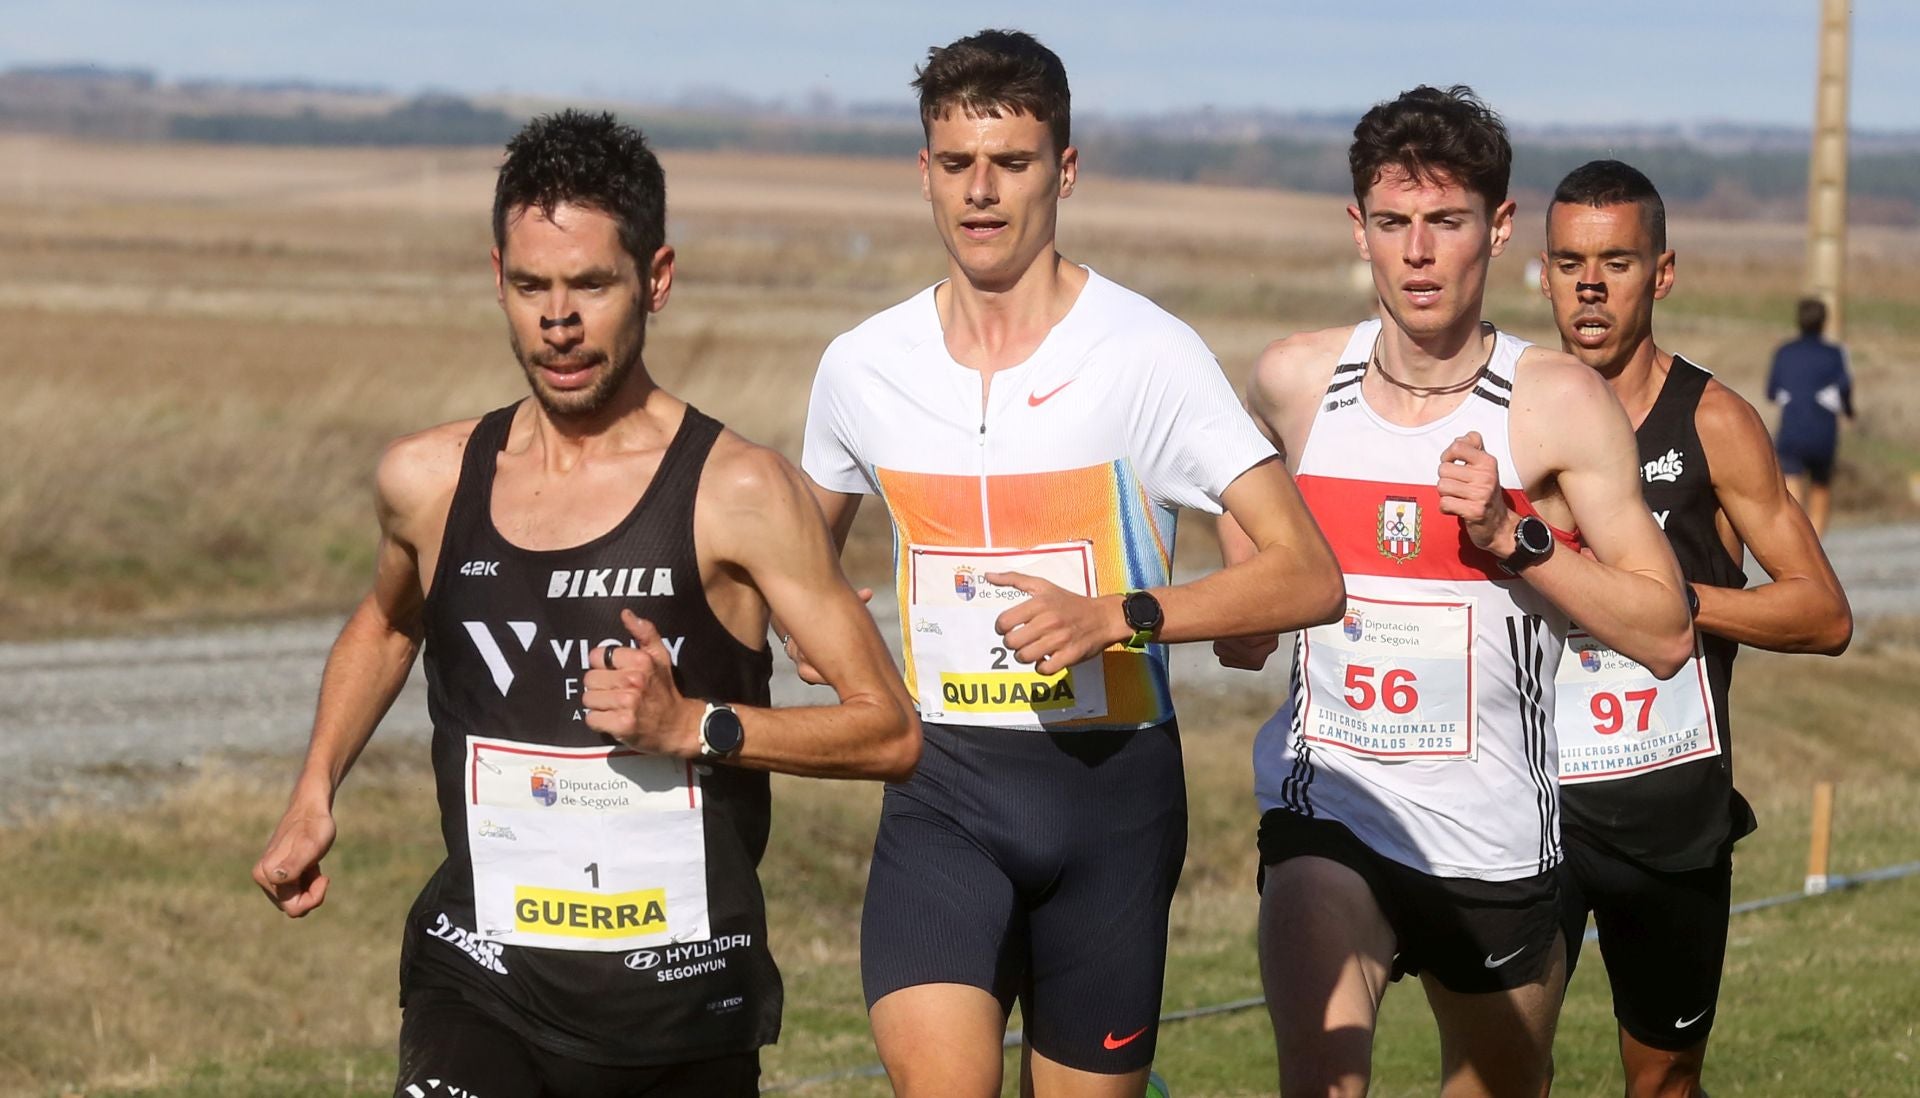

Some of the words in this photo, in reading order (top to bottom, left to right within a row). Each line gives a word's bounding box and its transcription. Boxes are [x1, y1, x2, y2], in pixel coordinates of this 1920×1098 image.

[460, 561, 500, 577] 42K
[547, 568, 675, 598] BIKILA
[979, 589, 991, 598] de
[1365, 619, 1419, 633] Diputación
[549, 636, 685, 669] VIY
[1364, 633, 1377, 643] de
[1380, 634, 1419, 646] Segovia
[990, 646, 1009, 670] 2
[1604, 660, 1616, 670] de
[942, 678, 1075, 705] QUIJADA
[1343, 663, 1419, 715] 56
[1318, 709, 1337, 721] LIII
[1339, 714, 1368, 732] CROSS
[1371, 722, 1436, 735] NACIONAL
[1440, 723, 1456, 733] DE
[1589, 686, 1659, 736] 97
[1318, 723, 1406, 749] CANTIMPALOS
[1418, 737, 1453, 749] 2025
[1560, 748, 1581, 758] LIII
[1585, 744, 1620, 756] CROSS
[1624, 732, 1682, 753] NACIONAL
[1686, 728, 1699, 739] DE
[1564, 753, 1658, 773] CANTIMPALOS
[1668, 740, 1697, 757] 2025
[559, 777, 628, 793] Diputación
[560, 795, 577, 806] de
[580, 796, 629, 809] Segovia
[583, 862, 600, 889] 1
[515, 898, 667, 930] GUERRA
[666, 934, 751, 964] HYUNDAI
[657, 958, 726, 982] SEGOHYUN
